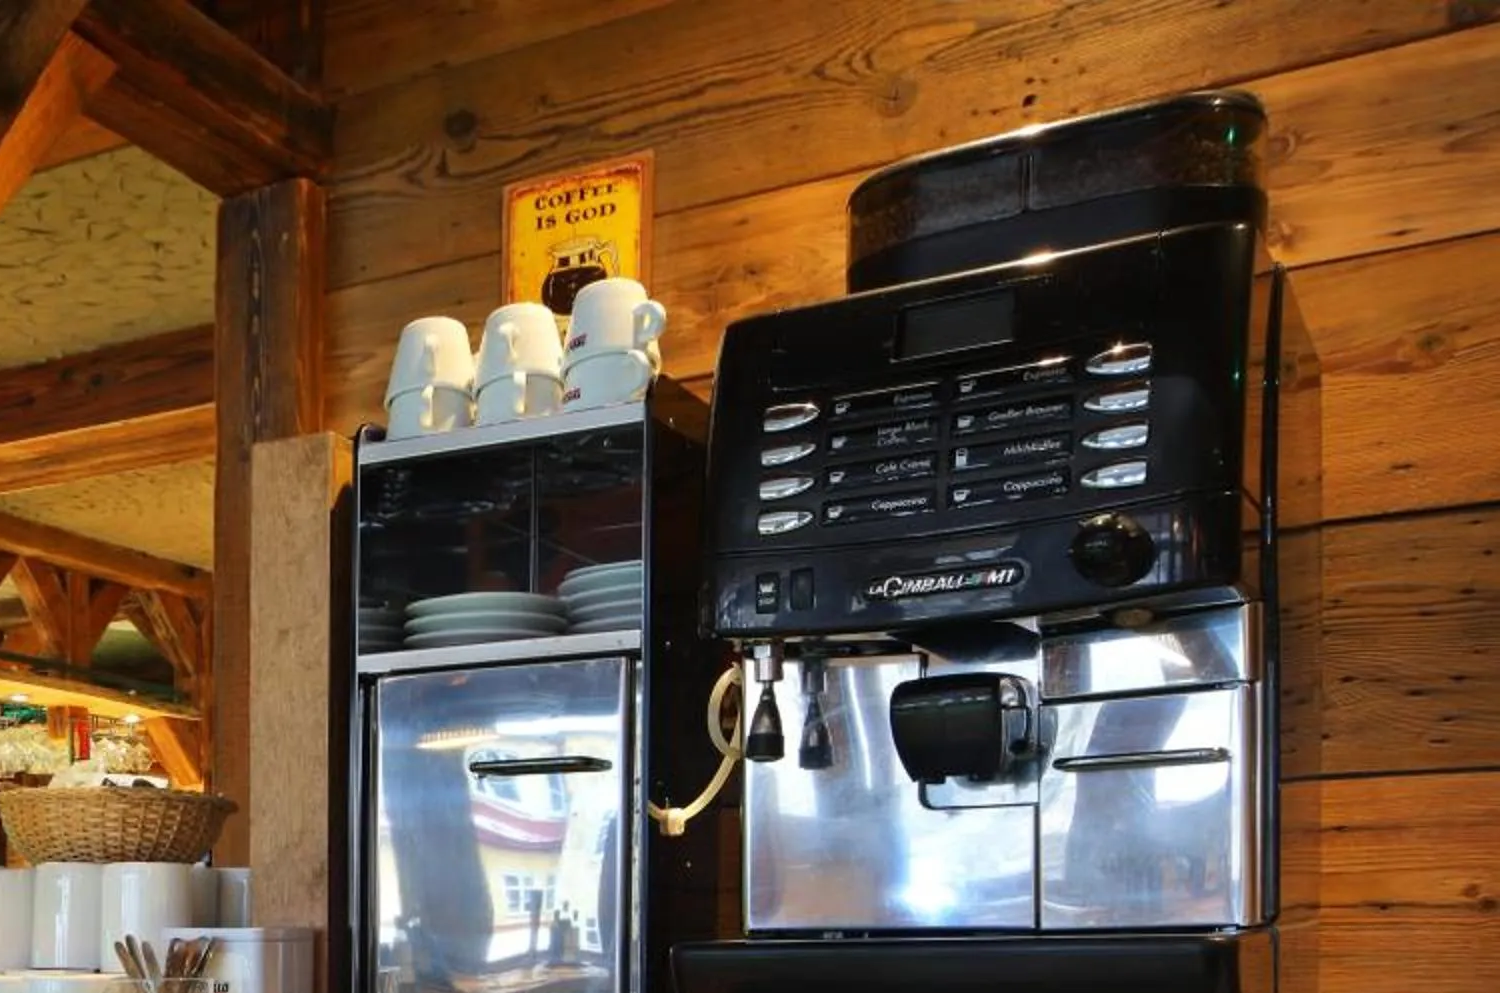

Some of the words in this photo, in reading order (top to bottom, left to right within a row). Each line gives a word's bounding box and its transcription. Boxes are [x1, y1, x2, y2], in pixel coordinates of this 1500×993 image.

[534, 183, 619, 211] COFFEE
[535, 215, 557, 231] IS
[564, 202, 617, 225] GOD
